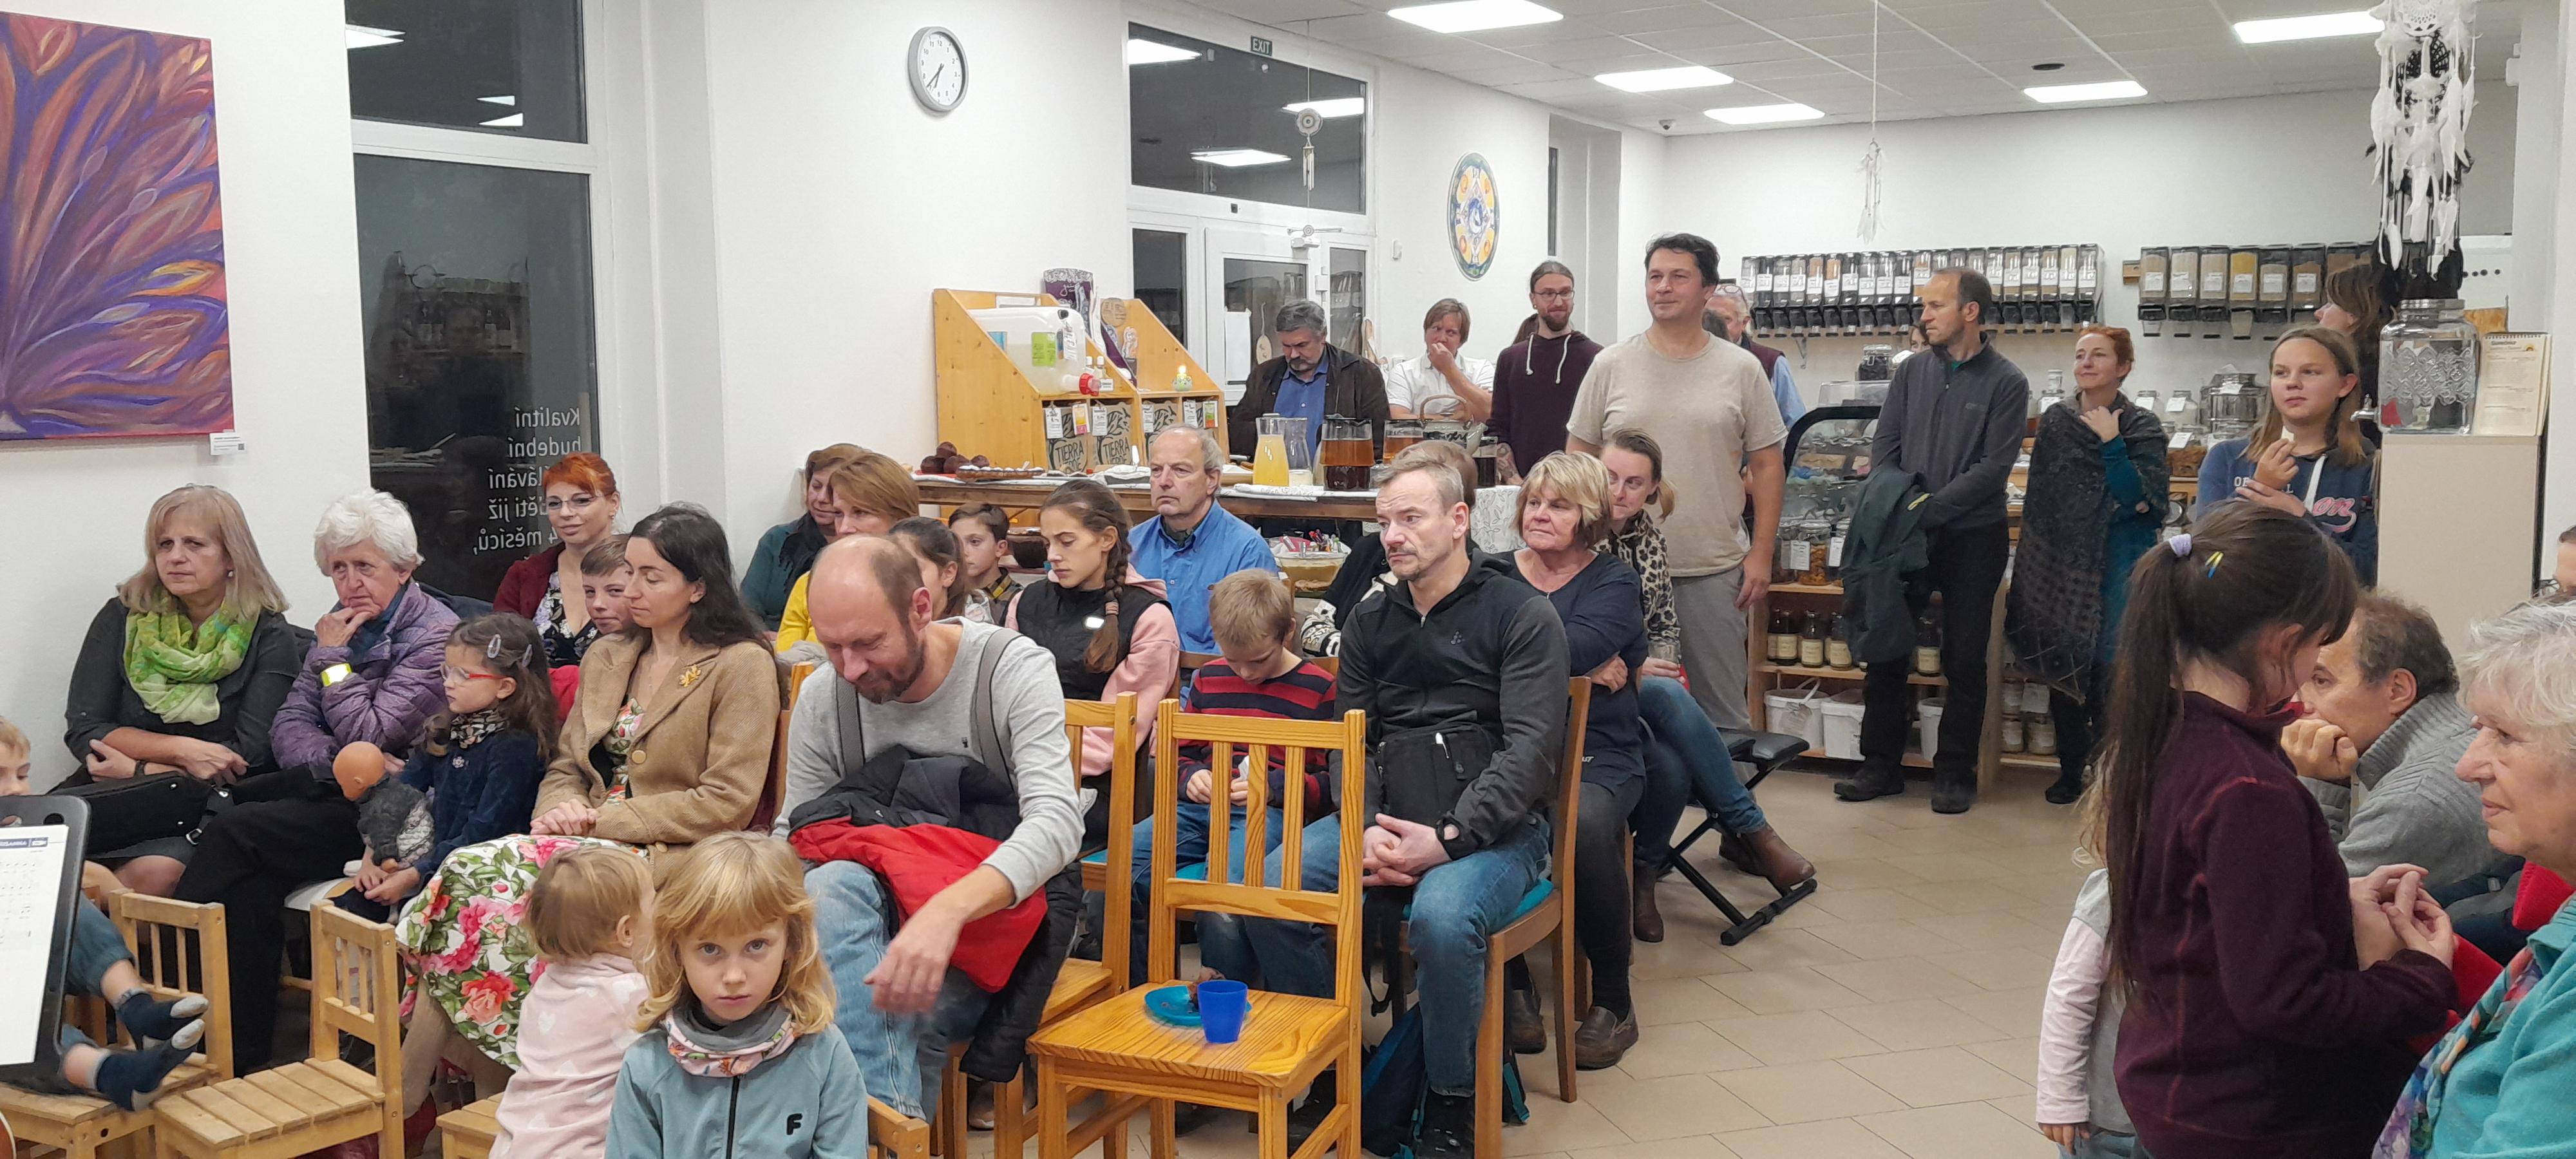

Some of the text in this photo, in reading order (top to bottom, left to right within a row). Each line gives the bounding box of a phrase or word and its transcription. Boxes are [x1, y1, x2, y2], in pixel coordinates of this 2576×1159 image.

[1253, 39, 1271, 54] EXIT
[1055, 440, 1084, 463] TIERRA
[1103, 437, 1130, 461] TIERRA
[786, 1113, 803, 1135] F
